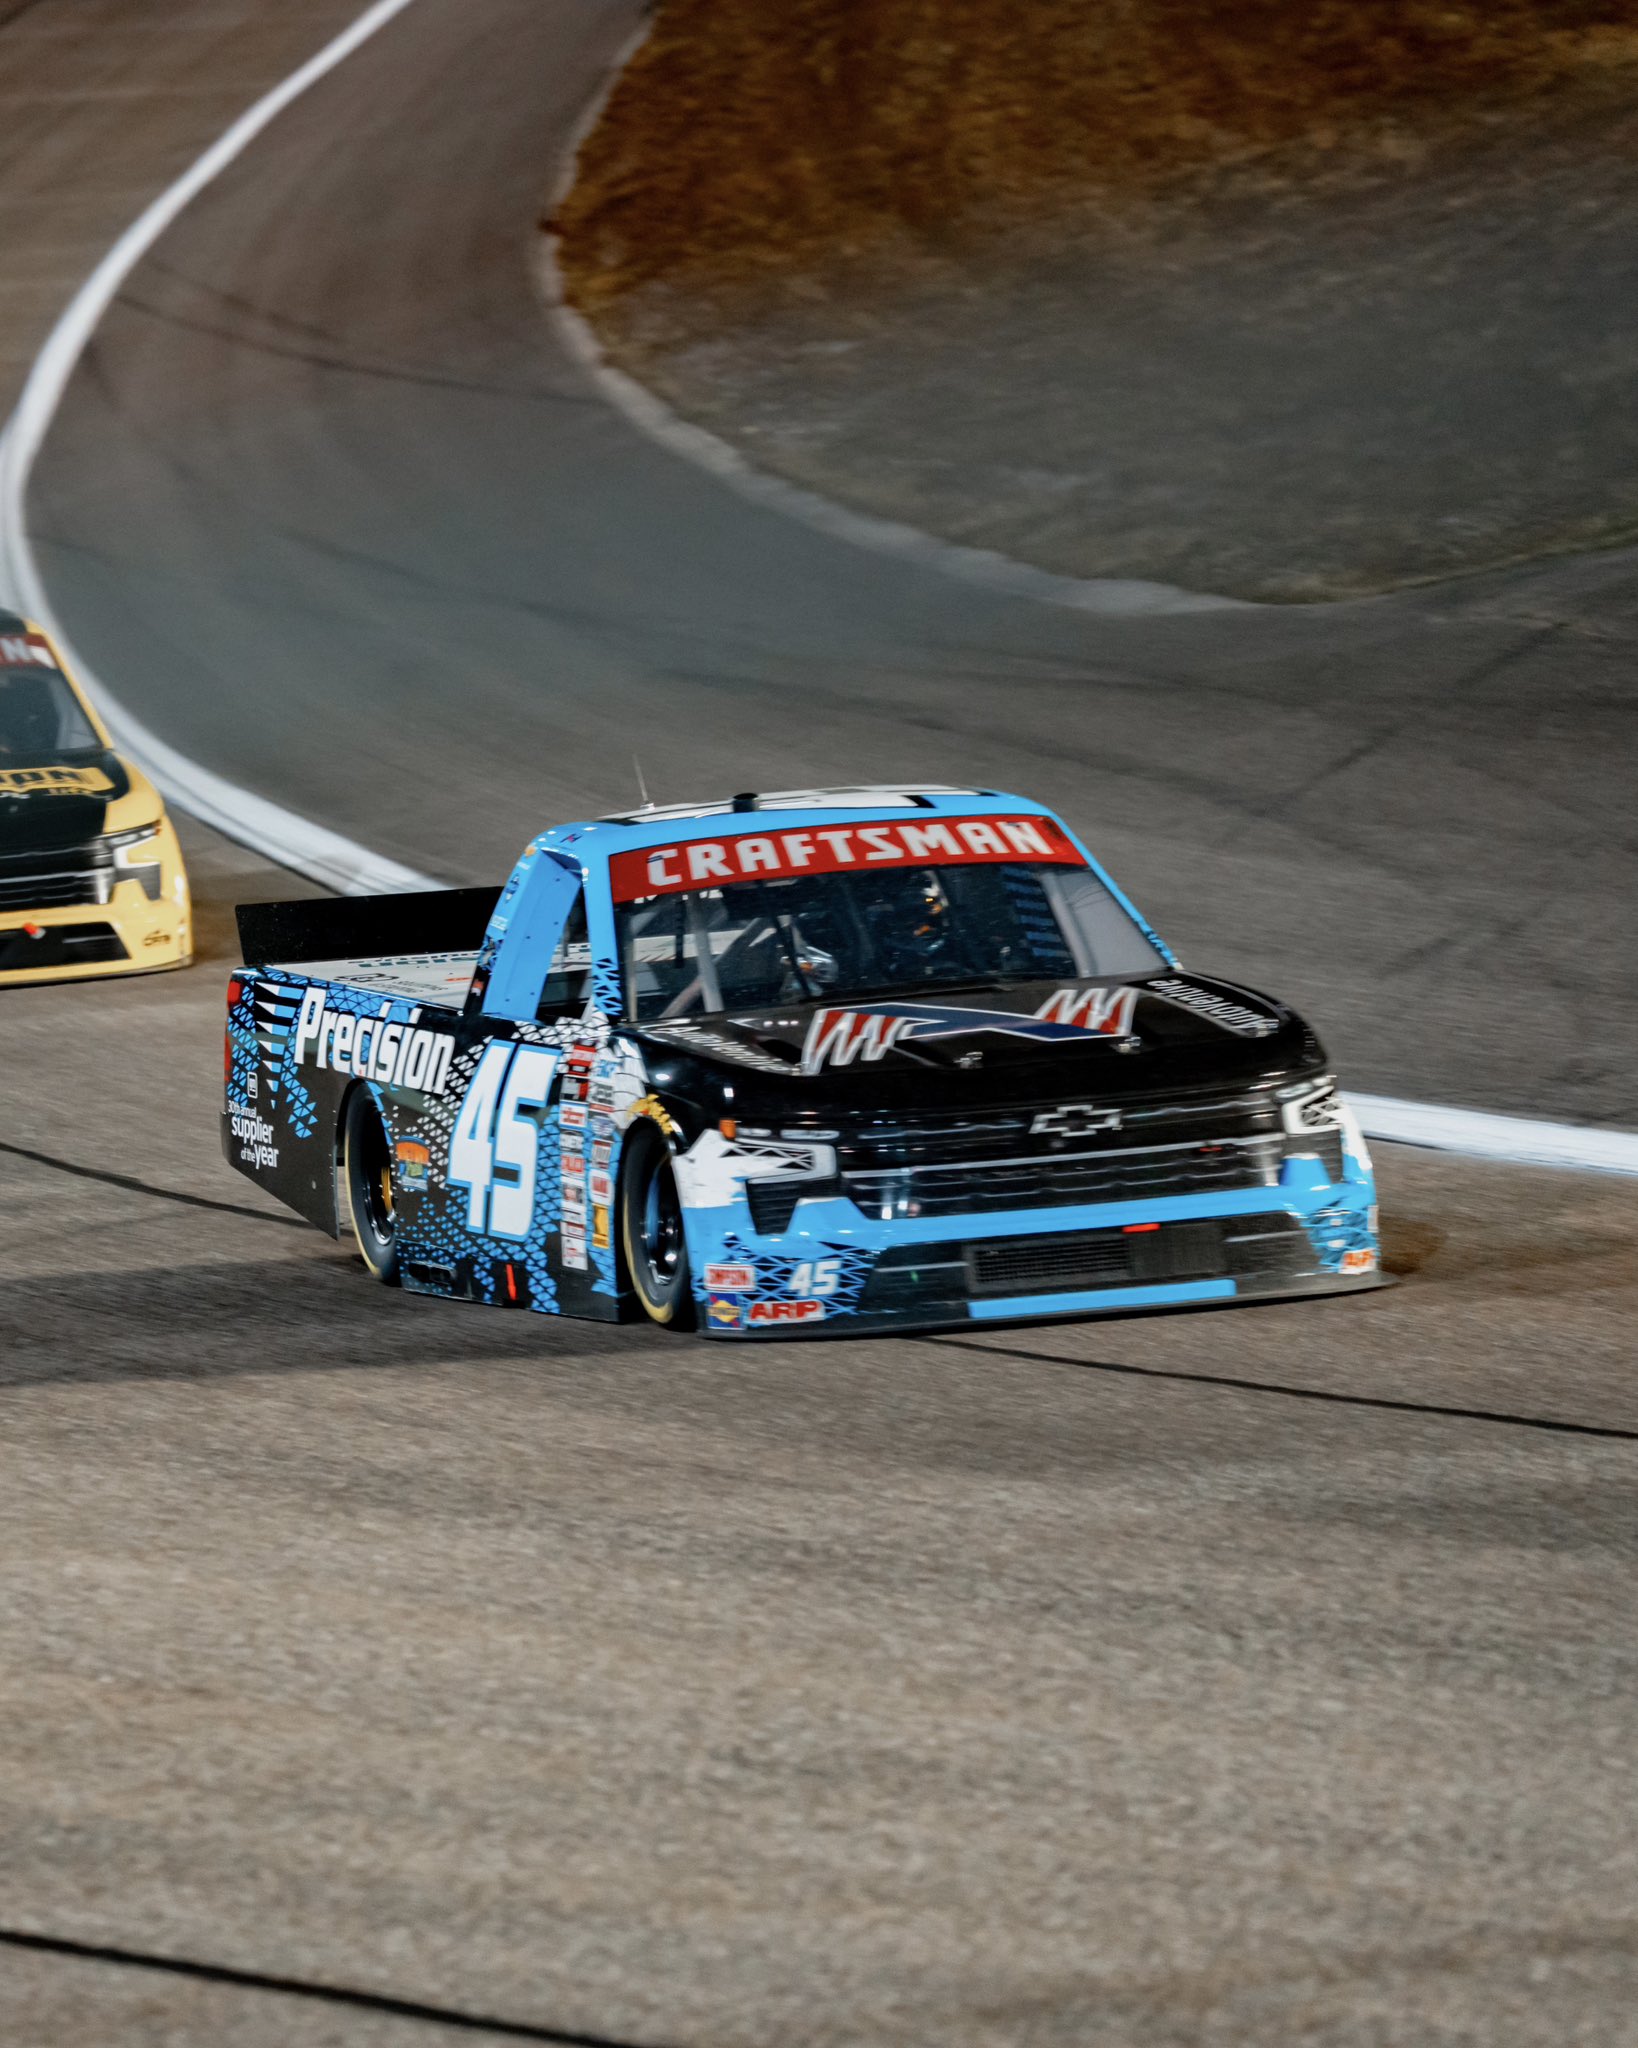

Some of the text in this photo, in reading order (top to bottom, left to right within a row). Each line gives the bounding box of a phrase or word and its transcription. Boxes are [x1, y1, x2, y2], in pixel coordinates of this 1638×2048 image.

[646, 821, 1055, 887] CRAFTSMAN
[293, 986, 456, 1095] Precision
[240, 1104, 257, 1119] annual
[231, 1115, 274, 1146] supplier
[446, 1039, 563, 1243] 45
[253, 1143, 279, 1170] year
[787, 1260, 844, 1297] 45
[750, 1300, 820, 1320] ARP
